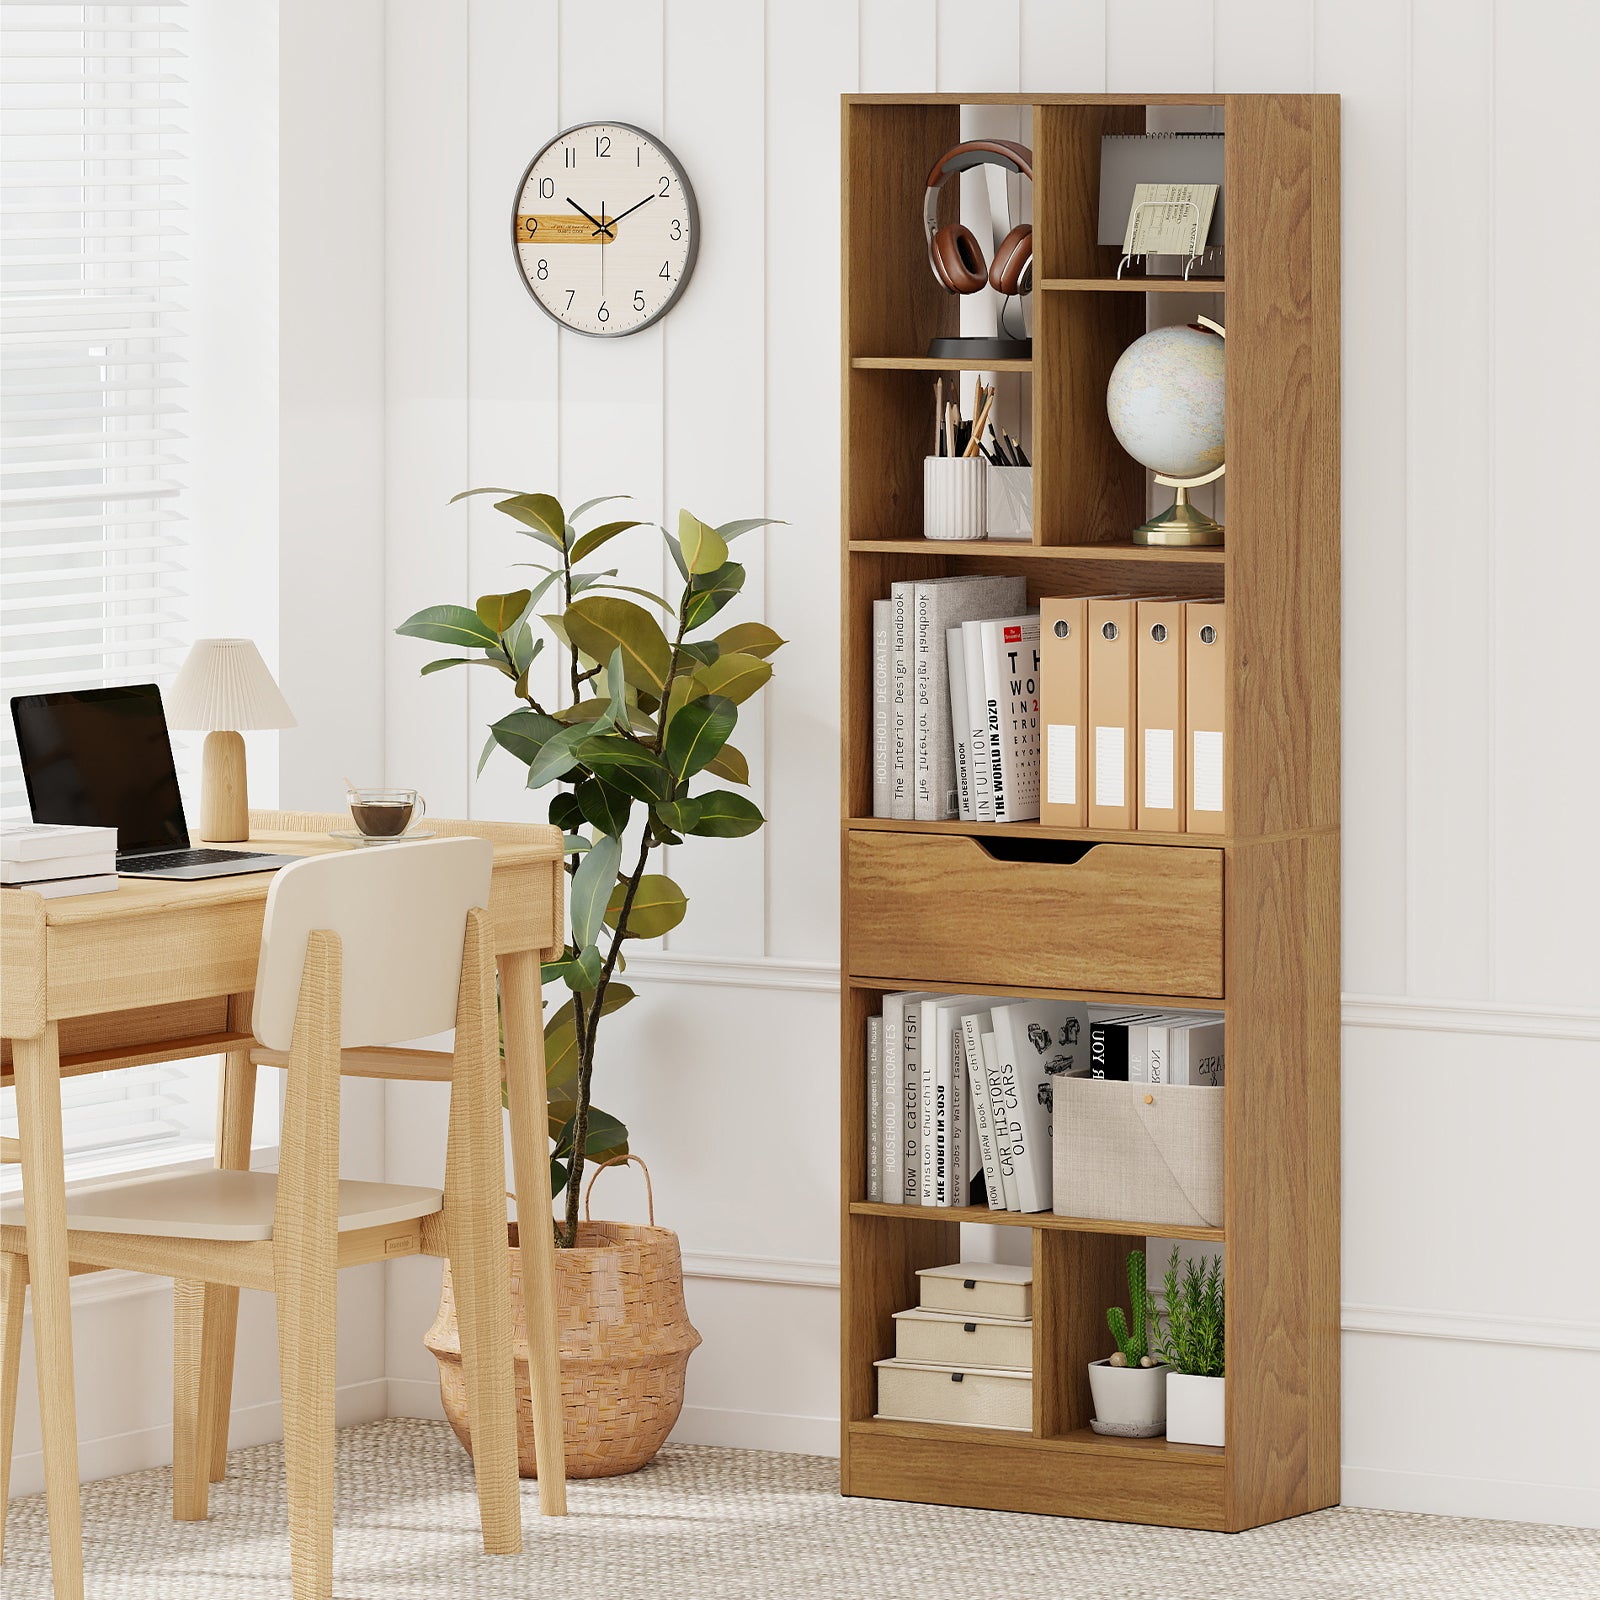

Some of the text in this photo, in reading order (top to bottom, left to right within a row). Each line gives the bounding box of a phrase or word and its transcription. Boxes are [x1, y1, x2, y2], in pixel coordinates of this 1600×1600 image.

[565, 147, 576, 168] 11
[595, 136, 611, 158] 12
[538, 177, 555, 199] 10
[658, 176, 670, 198] 2
[525, 217, 538, 239] 9
[669, 219, 682, 241] 3
[536, 259, 549, 281] 8
[658, 260, 671, 282] 4
[565, 289, 576, 311] 7
[632, 290, 646, 312] 5
[597, 301, 610, 323] 6
[876, 630, 888, 784] HOUSEHOLD DECORATES
[895, 592, 906, 800] The Interior Design Handbook
[987, 699, 1005, 817] THE WORLD IN 2020
[973, 729, 990, 816] INTUITION
[885, 1023, 896, 1173] HOUSEHOLD DECORATES
[905, 1015, 917, 1198] How to catch a fish
[964, 1020, 999, 1206] HOW TO DRAW Book for children
[1000, 1063, 1025, 1156] OLD CARS
[923, 1068, 931, 1198] Winston Churchill
[953, 1126, 962, 1139] by
[987, 1067, 1014, 1177] CAR HISTORY
[871, 1132, 877, 1142] an
[870, 1167, 877, 1177] to
